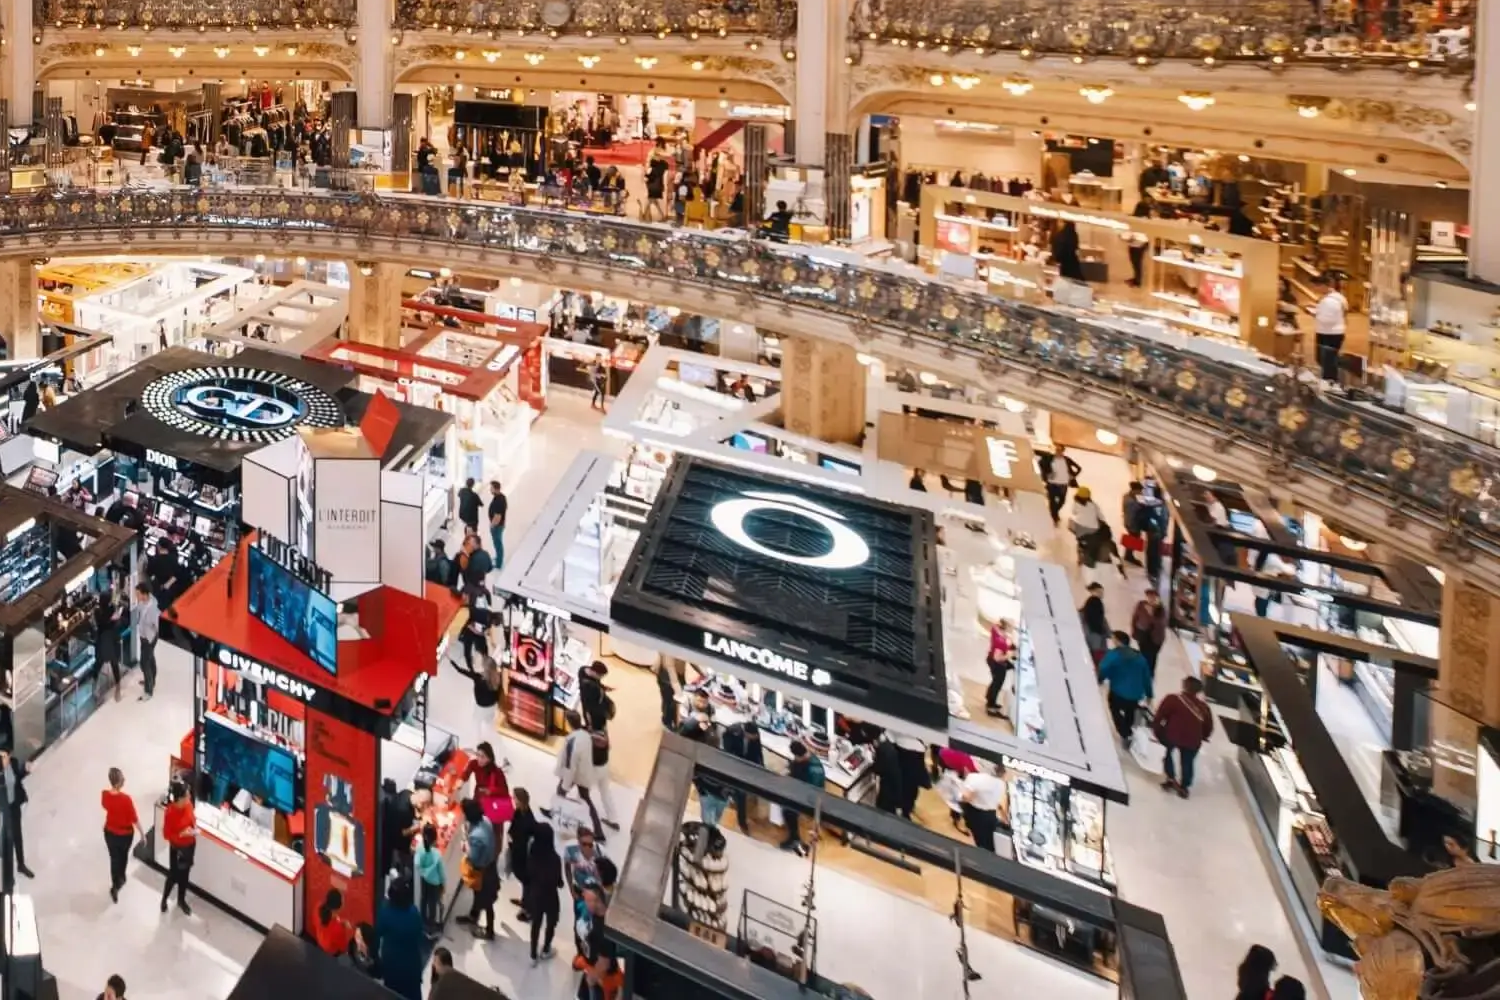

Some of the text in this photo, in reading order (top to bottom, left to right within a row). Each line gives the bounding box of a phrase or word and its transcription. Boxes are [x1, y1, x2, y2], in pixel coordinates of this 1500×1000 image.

[146, 449, 177, 470] DIOR
[318, 508, 376, 523] L'INTERDIT
[218, 648, 316, 701] GIVENCHY
